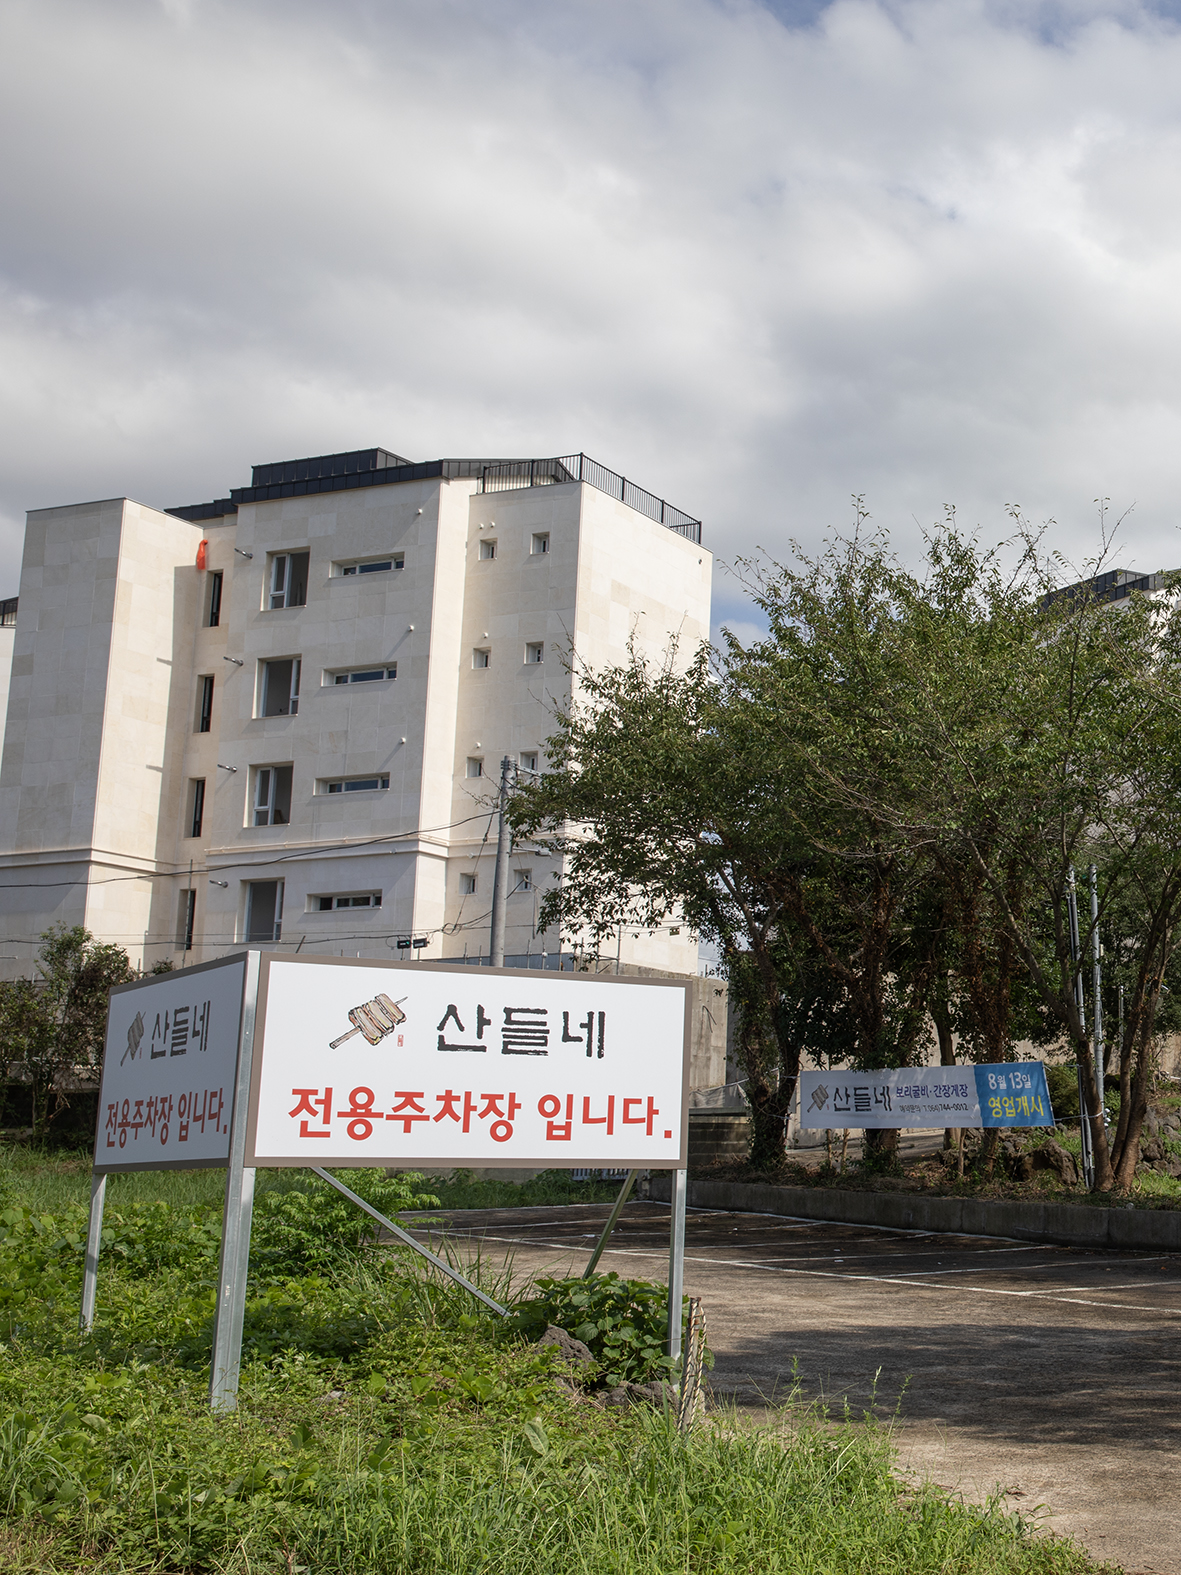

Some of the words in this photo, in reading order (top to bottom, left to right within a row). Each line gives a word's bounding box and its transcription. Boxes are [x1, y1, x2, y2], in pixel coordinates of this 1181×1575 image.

[150, 1000, 211, 1060] 산들네
[436, 1004, 606, 1059] 산들네
[833, 1086, 893, 1113] 산들네
[987, 1072, 1007, 1090] 8월
[1008, 1071, 1032, 1089] 13일
[987, 1095, 1045, 1118] 영업개시
[105, 1094, 173, 1149] 전용주차장
[178, 1088, 228, 1142] 입니다.
[288, 1086, 522, 1143] 전용주차장
[537, 1093, 673, 1141] 입니다.
